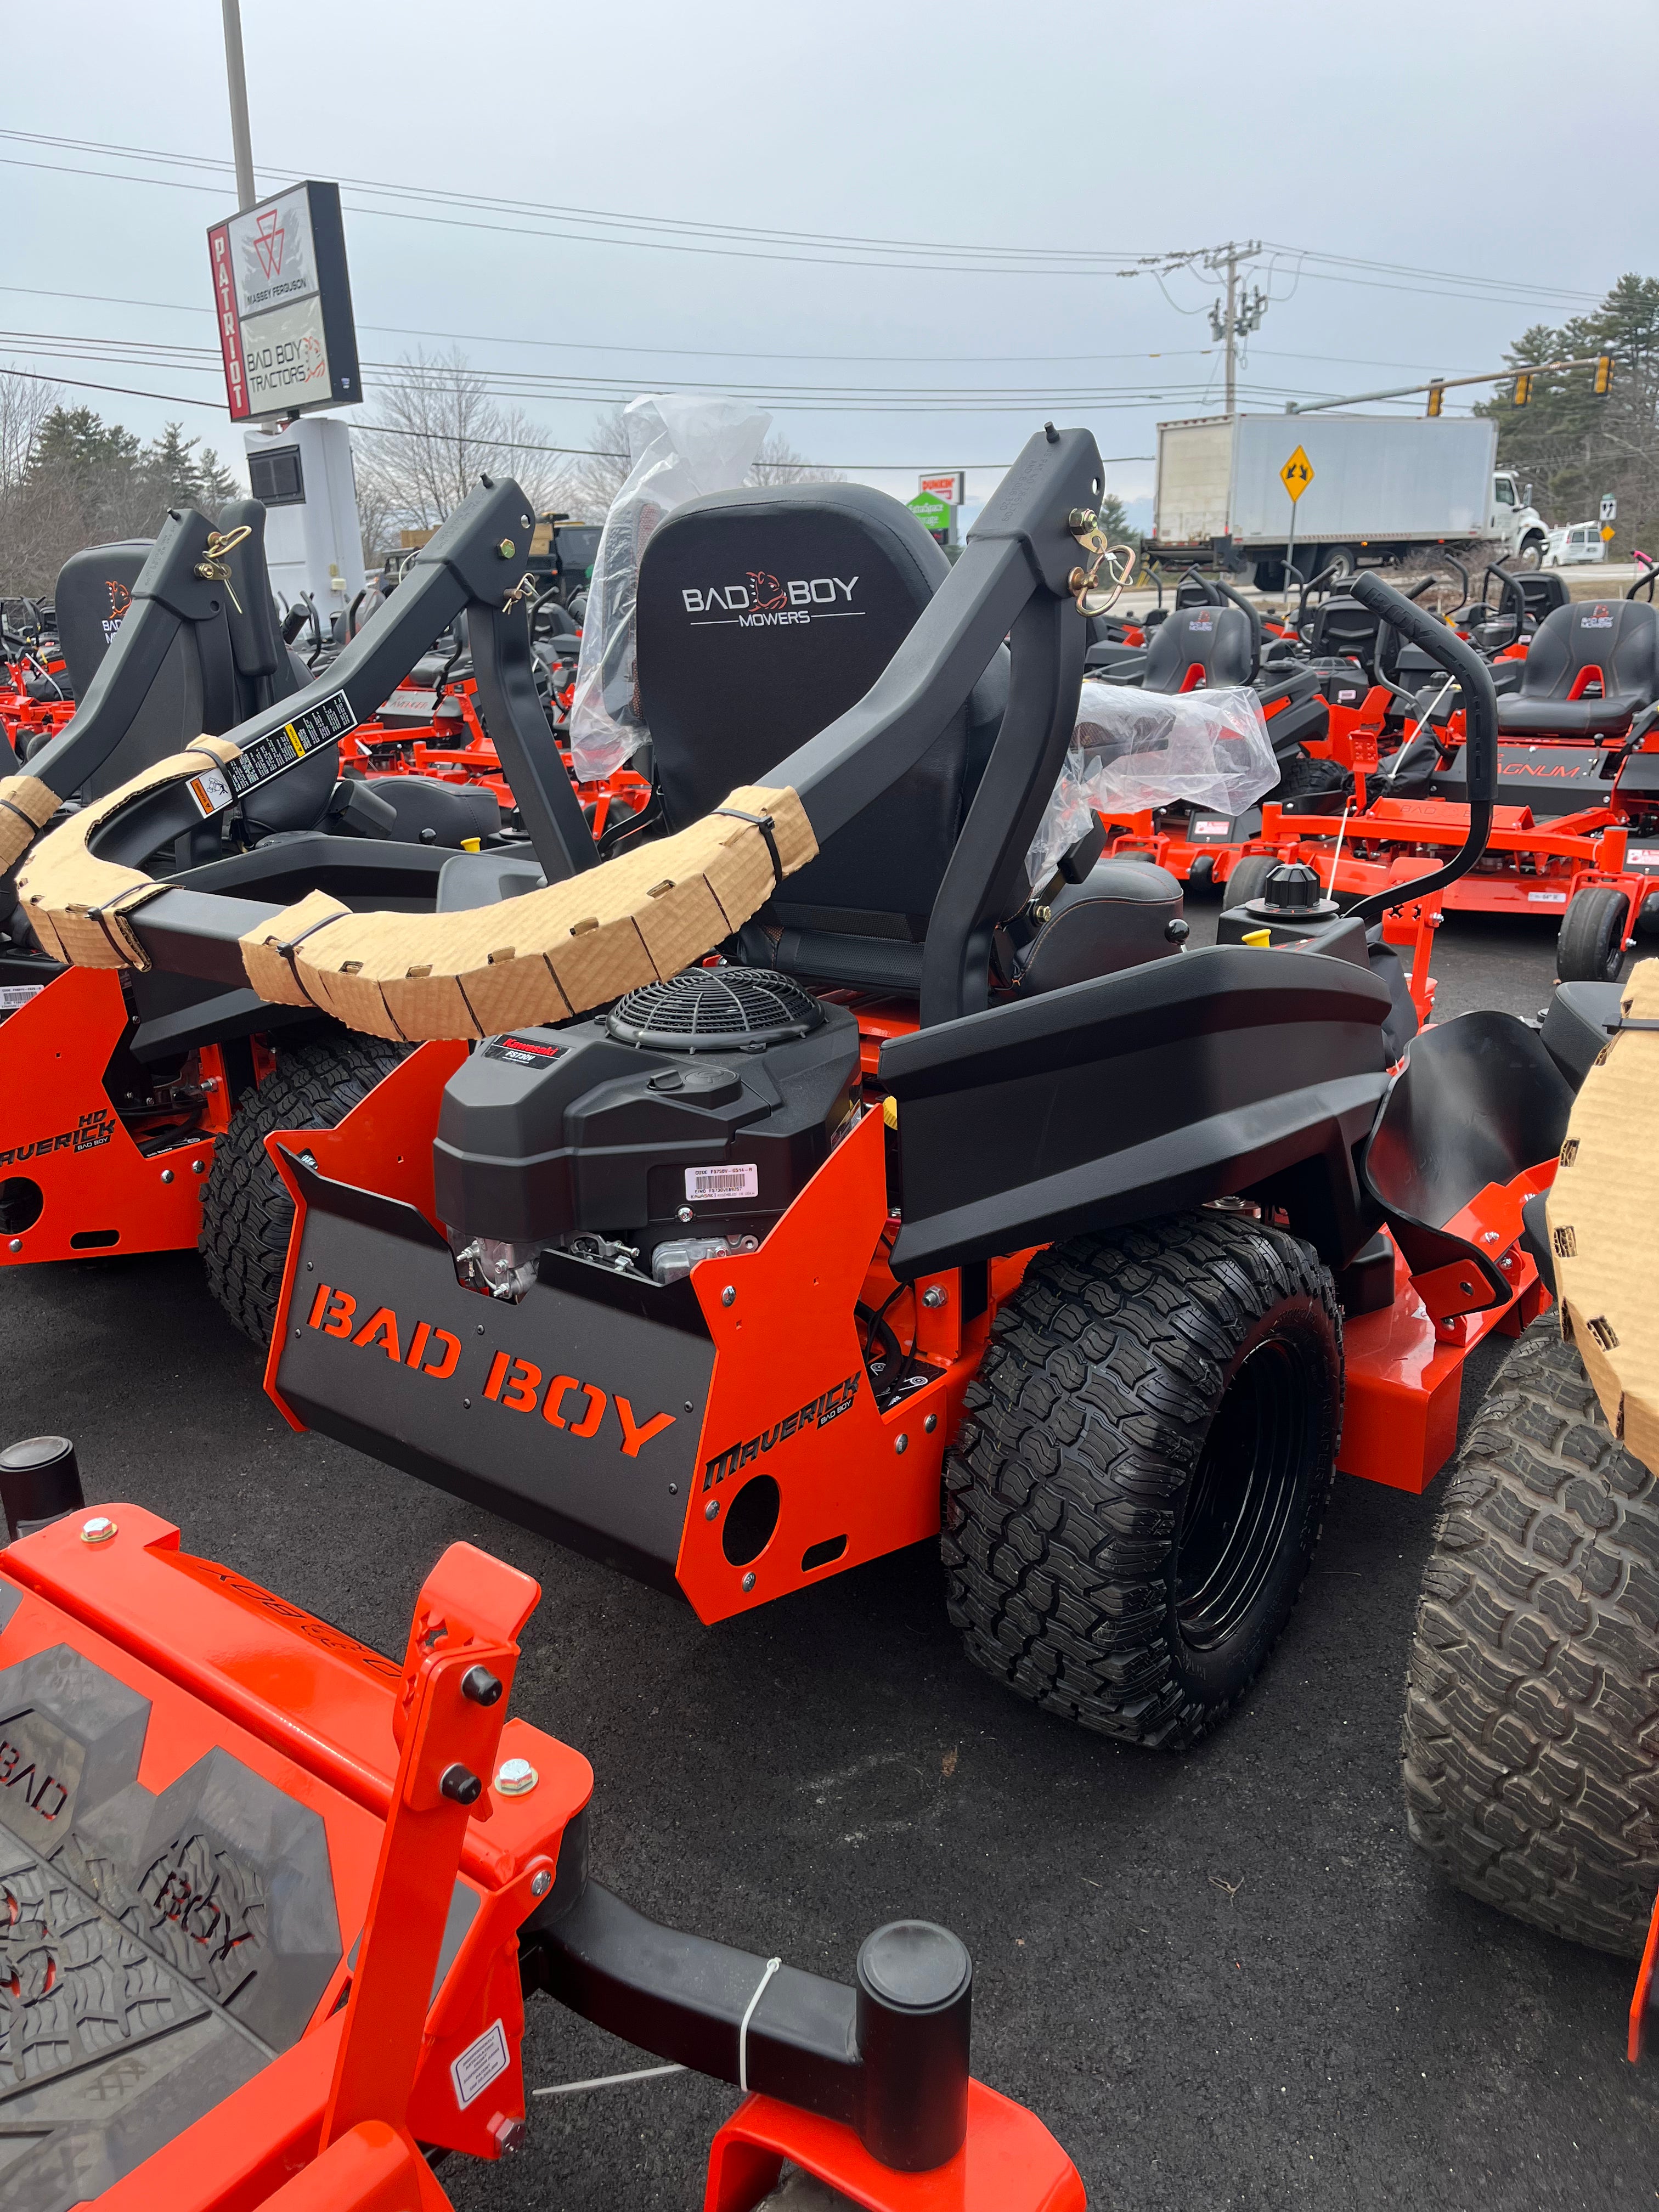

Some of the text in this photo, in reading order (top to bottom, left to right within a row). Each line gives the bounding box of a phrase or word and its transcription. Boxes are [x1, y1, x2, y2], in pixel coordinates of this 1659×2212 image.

[247, 277, 306, 306] MASSEY FERGUSON
[215, 237, 242, 409] PATRIOT
[247, 340, 302, 372] BAD BOY
[250, 365, 305, 393] TRACTORS
[682, 577, 859, 612] BAD BOY
[739, 611, 810, 627] MOWERS
[502, 1038, 560, 1057] Kawasaki
[505, 1051, 536, 1061] FS730V
[78, 1108, 108, 1128] HD
[0, 1119, 116, 1167] AVERICK
[77, 1137, 108, 1150] BAD BOY
[306, 1283, 677, 1458] BAD BOY
[821, 1399, 852, 1424] BAD BOY
[702, 1370, 861, 1493] MAVERICK
